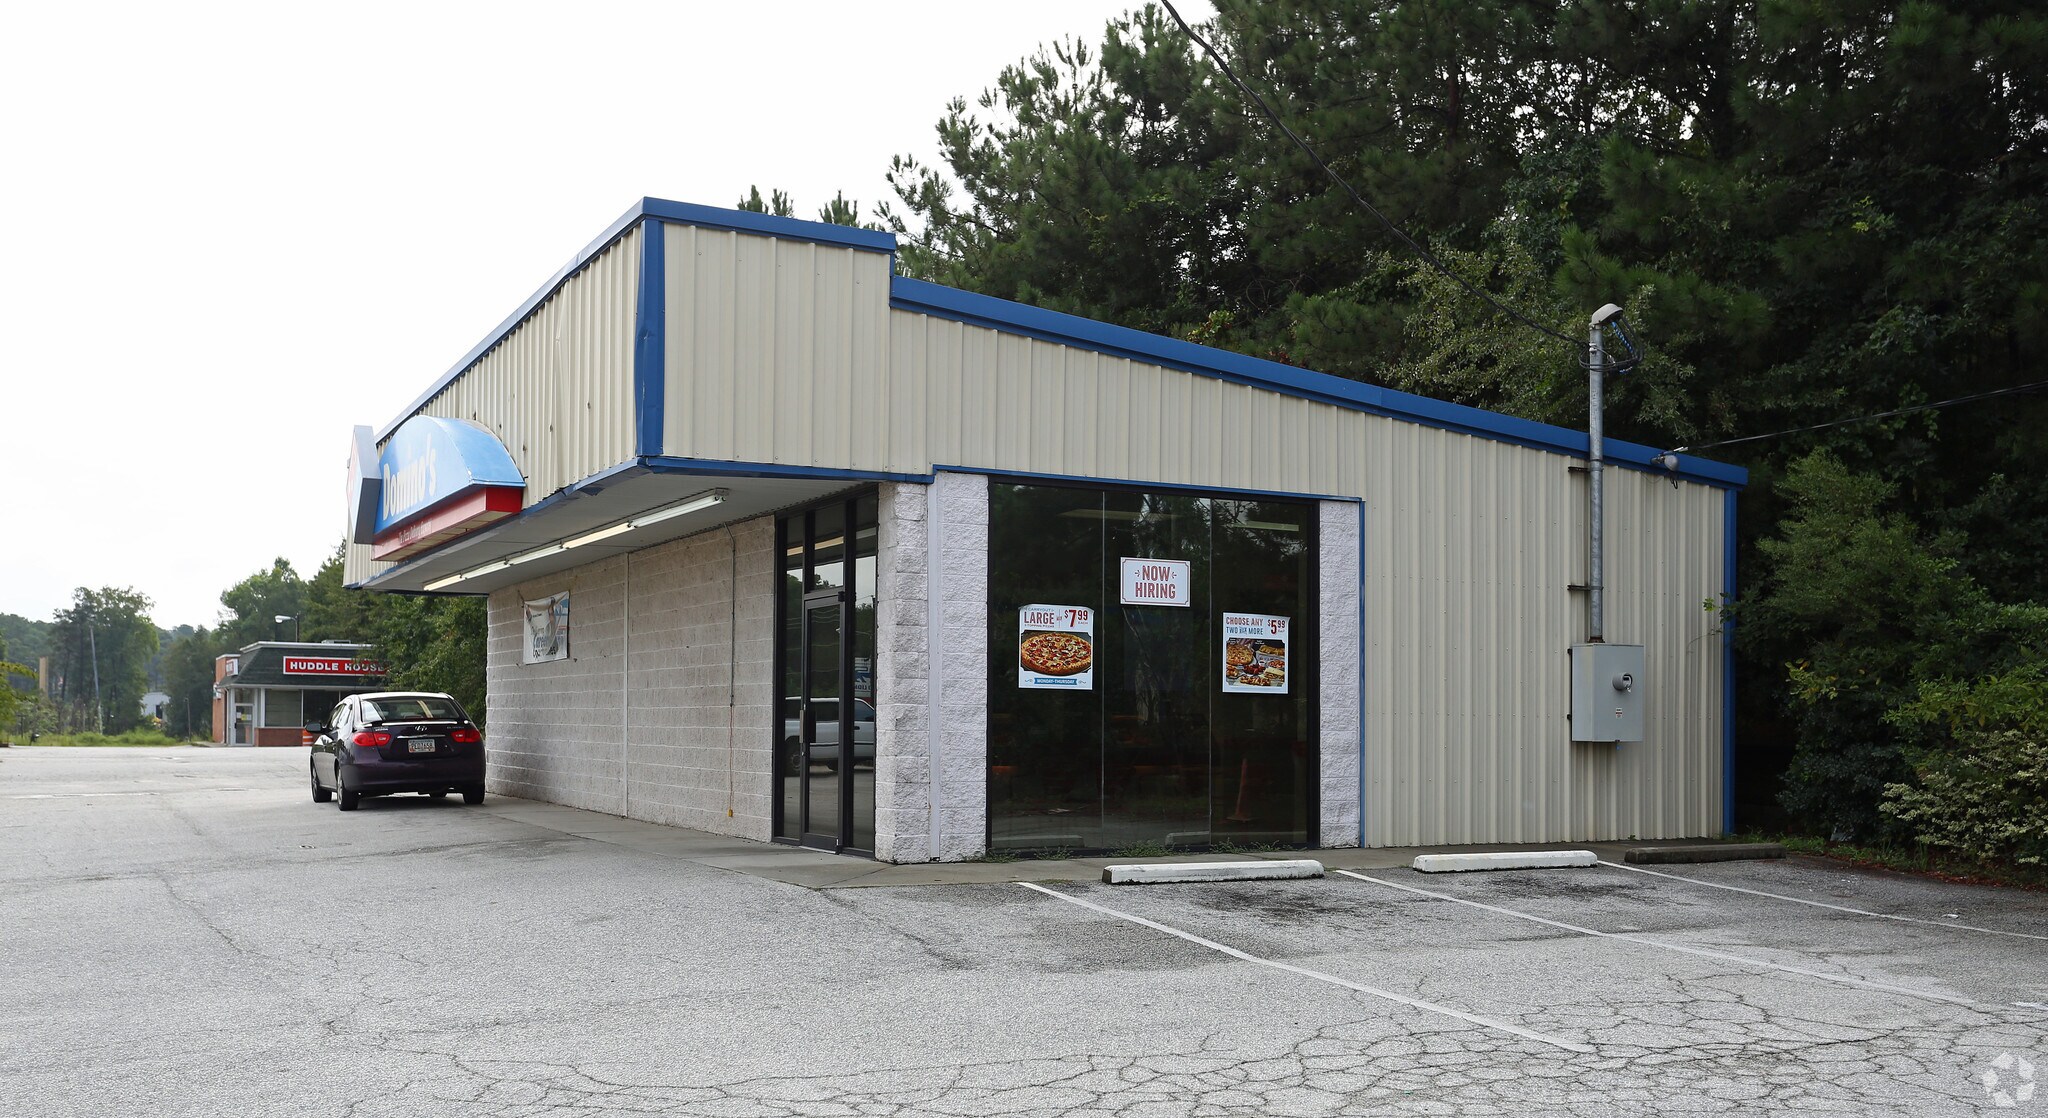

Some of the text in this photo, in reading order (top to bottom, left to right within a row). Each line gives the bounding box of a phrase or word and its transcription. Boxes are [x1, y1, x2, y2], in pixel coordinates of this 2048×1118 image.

[383, 433, 436, 520] Domino's
[1142, 565, 1171, 581] NOW
[1135, 582, 1176, 599] HIRING
[1024, 611, 1055, 625] LARGE
[1226, 616, 1264, 627] CHOOSE ANY
[1248, 627, 1264, 635] MORE
[290, 661, 340, 671] HUDDLE
